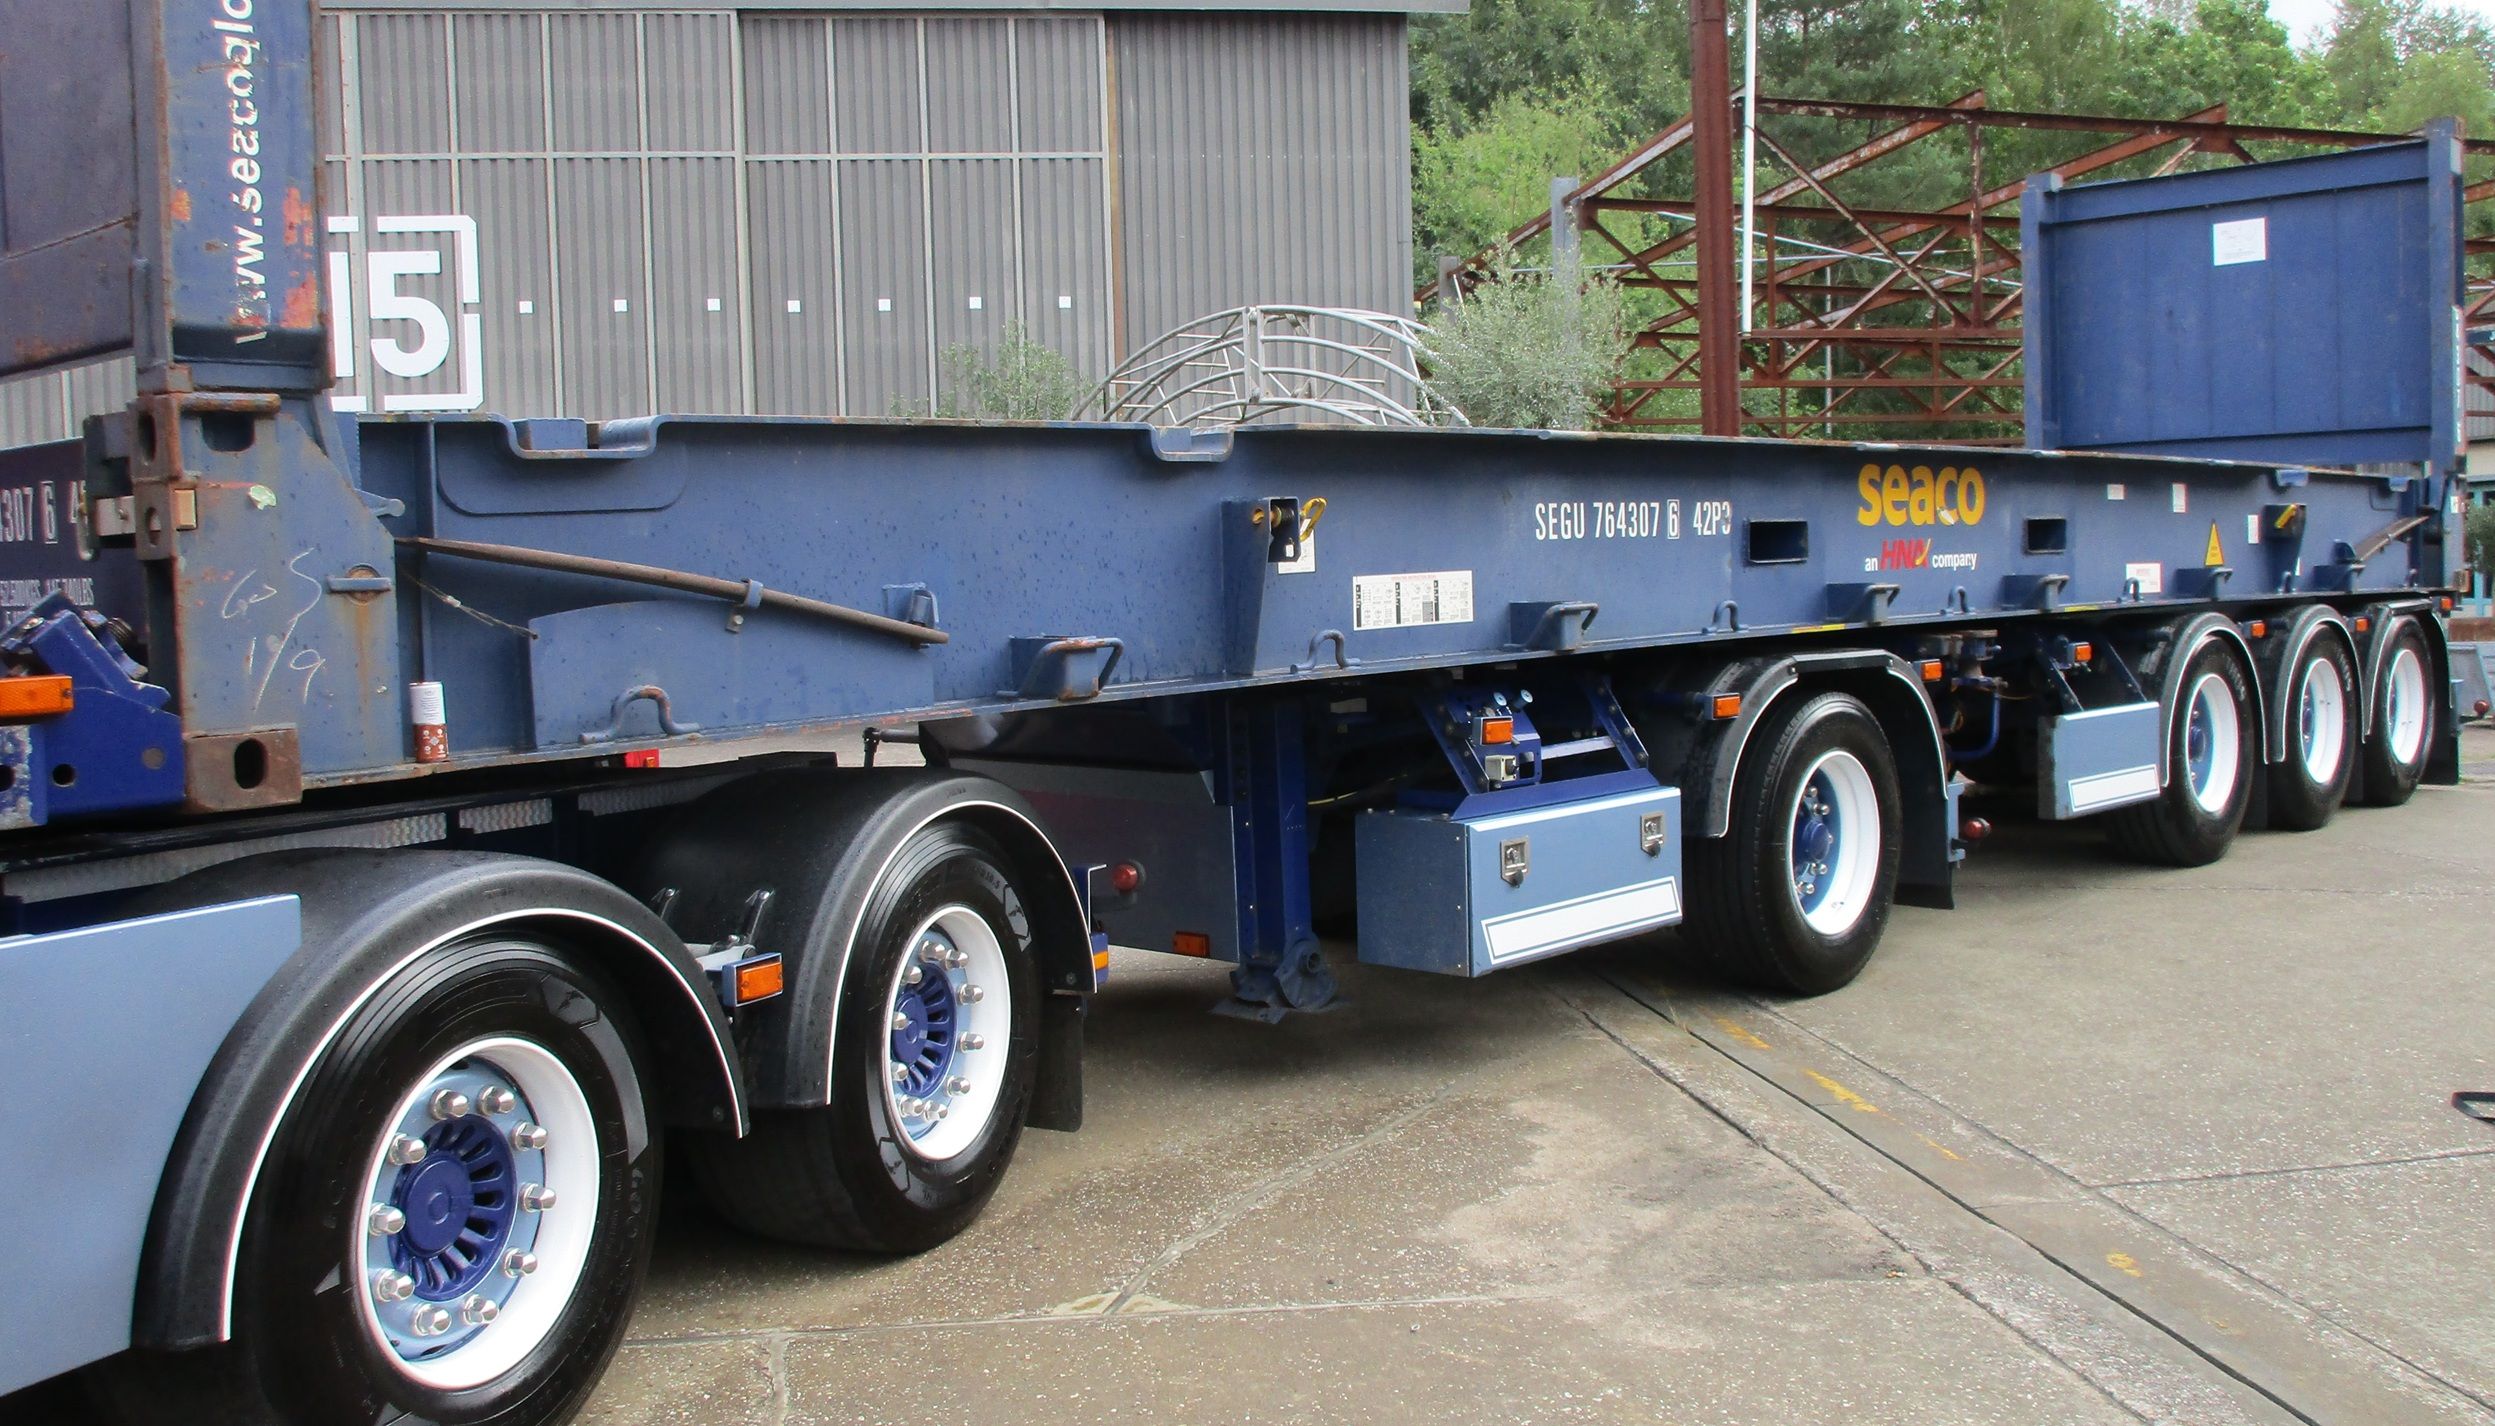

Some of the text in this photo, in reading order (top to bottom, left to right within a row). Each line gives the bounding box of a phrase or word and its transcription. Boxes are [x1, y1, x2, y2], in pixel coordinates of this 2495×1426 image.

[0, 487, 34, 542] 307
[42, 483, 57, 543] 6
[1858, 463, 1985, 527] seaco
[1535, 500, 1731, 541] SEGU 764307 6 42P3
[1864, 538, 1977, 571] an HNA company
